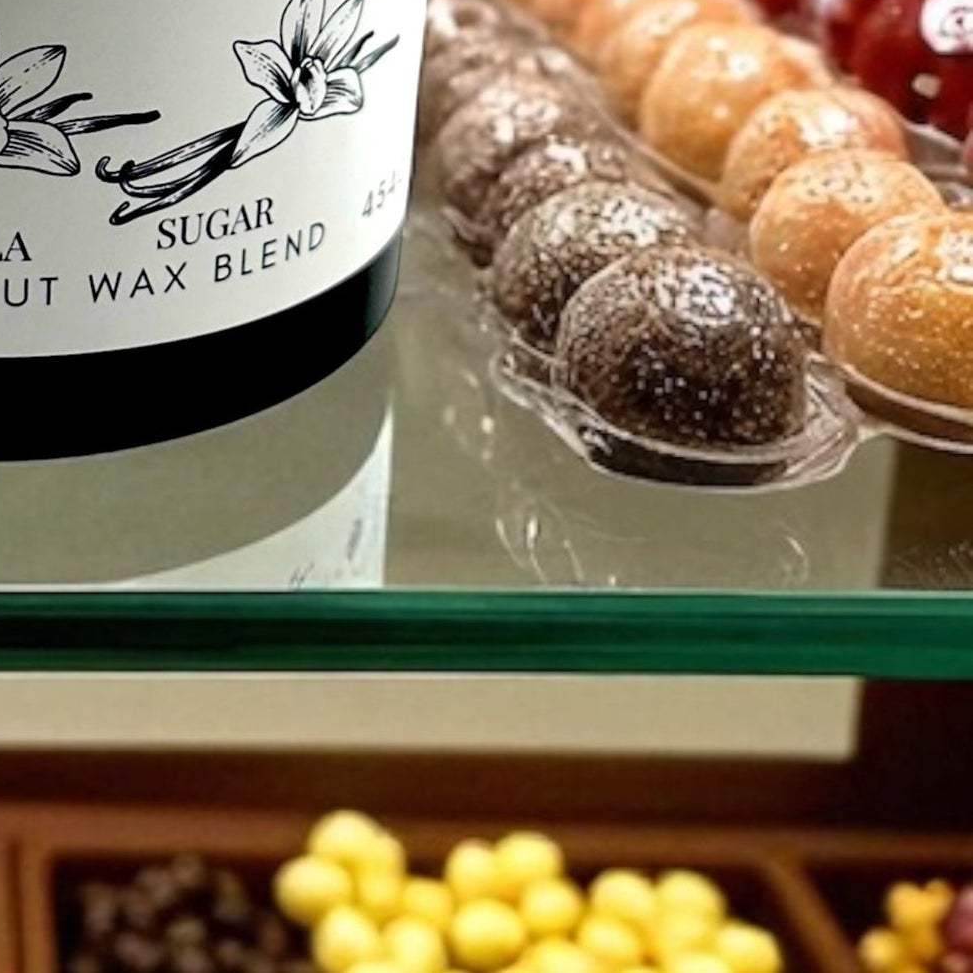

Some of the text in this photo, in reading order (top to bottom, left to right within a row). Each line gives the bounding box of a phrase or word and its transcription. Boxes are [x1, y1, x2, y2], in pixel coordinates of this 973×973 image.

[360, 169, 403, 218] 454
[157, 196, 275, 250] SUGAR
[88, 263, 188, 305] WAX
[213, 221, 327, 284] BLEND
